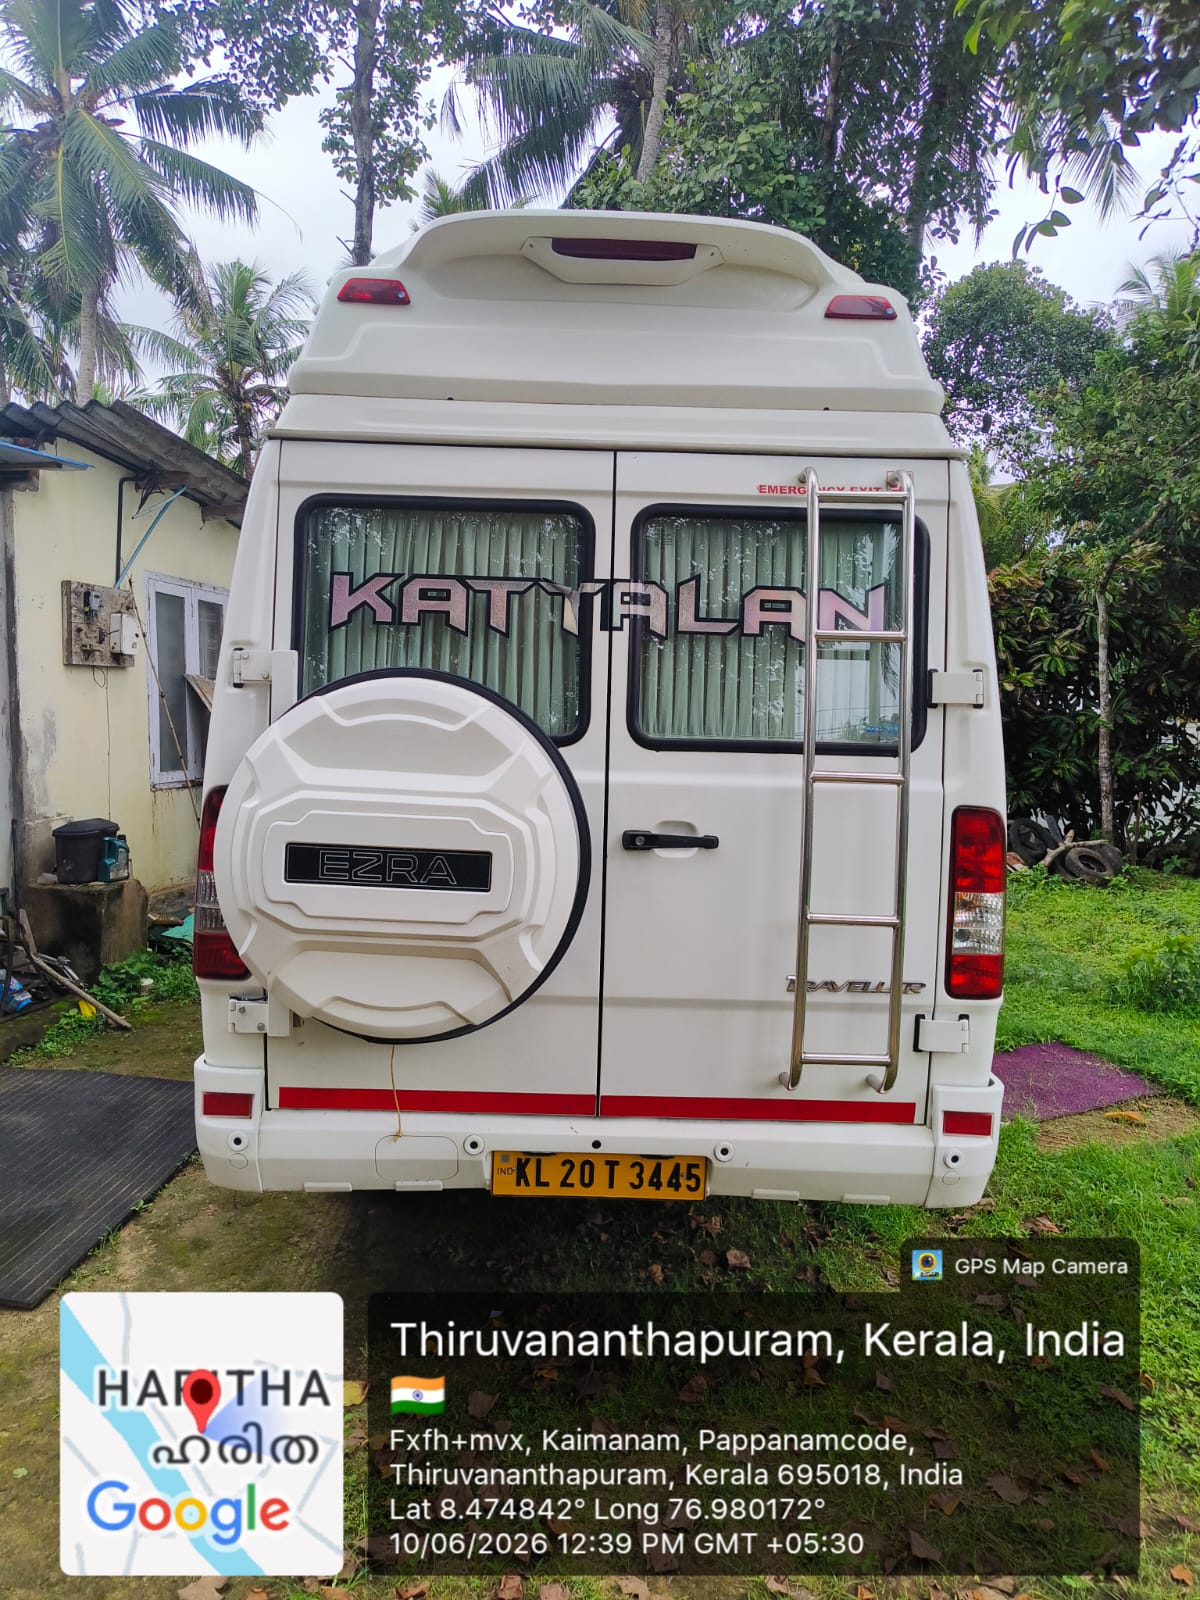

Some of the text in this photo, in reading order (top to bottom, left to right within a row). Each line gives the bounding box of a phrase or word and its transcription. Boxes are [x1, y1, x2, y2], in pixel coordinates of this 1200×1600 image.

[319, 850, 457, 885] EZRA
[786, 975, 926, 994] TRAVELLR
[497, 1157, 701, 1192] IND KL 20 T 3445
